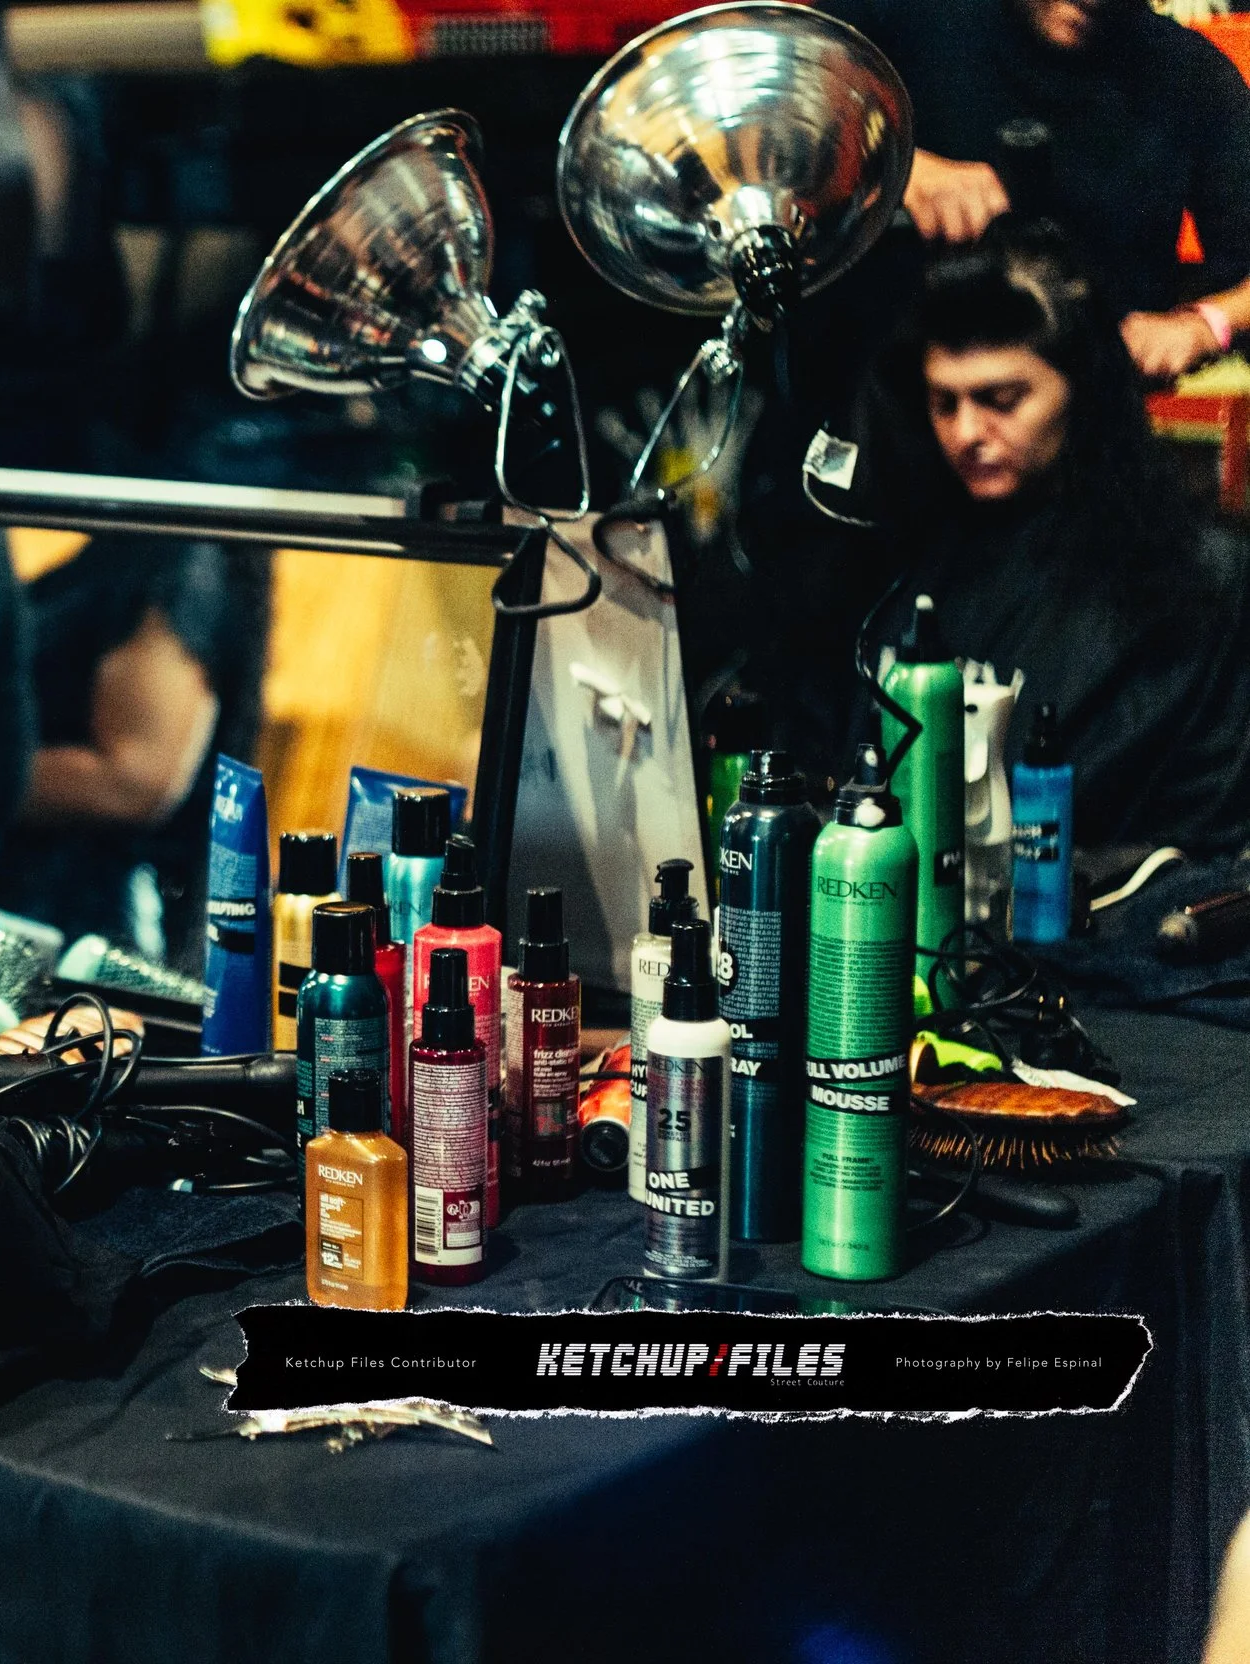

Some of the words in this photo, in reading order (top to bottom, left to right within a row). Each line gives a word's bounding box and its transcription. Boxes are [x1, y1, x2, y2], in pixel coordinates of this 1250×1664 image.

[816, 876, 897, 900] REDKEN
[639, 958, 670, 977] RED
[531, 1006, 579, 1023] REDKE
[730, 1024, 753, 1039] OL
[730, 1057, 761, 1077] RAY
[806, 1060, 831, 1079] ULL
[830, 1054, 906, 1079] VOLUME
[812, 1085, 890, 1111] MOUSSE
[658, 1107, 692, 1132] 25
[318, 1164, 363, 1186] REDKEN
[649, 1172, 690, 1190] ONE
[645, 1190, 715, 1217] UNITED
